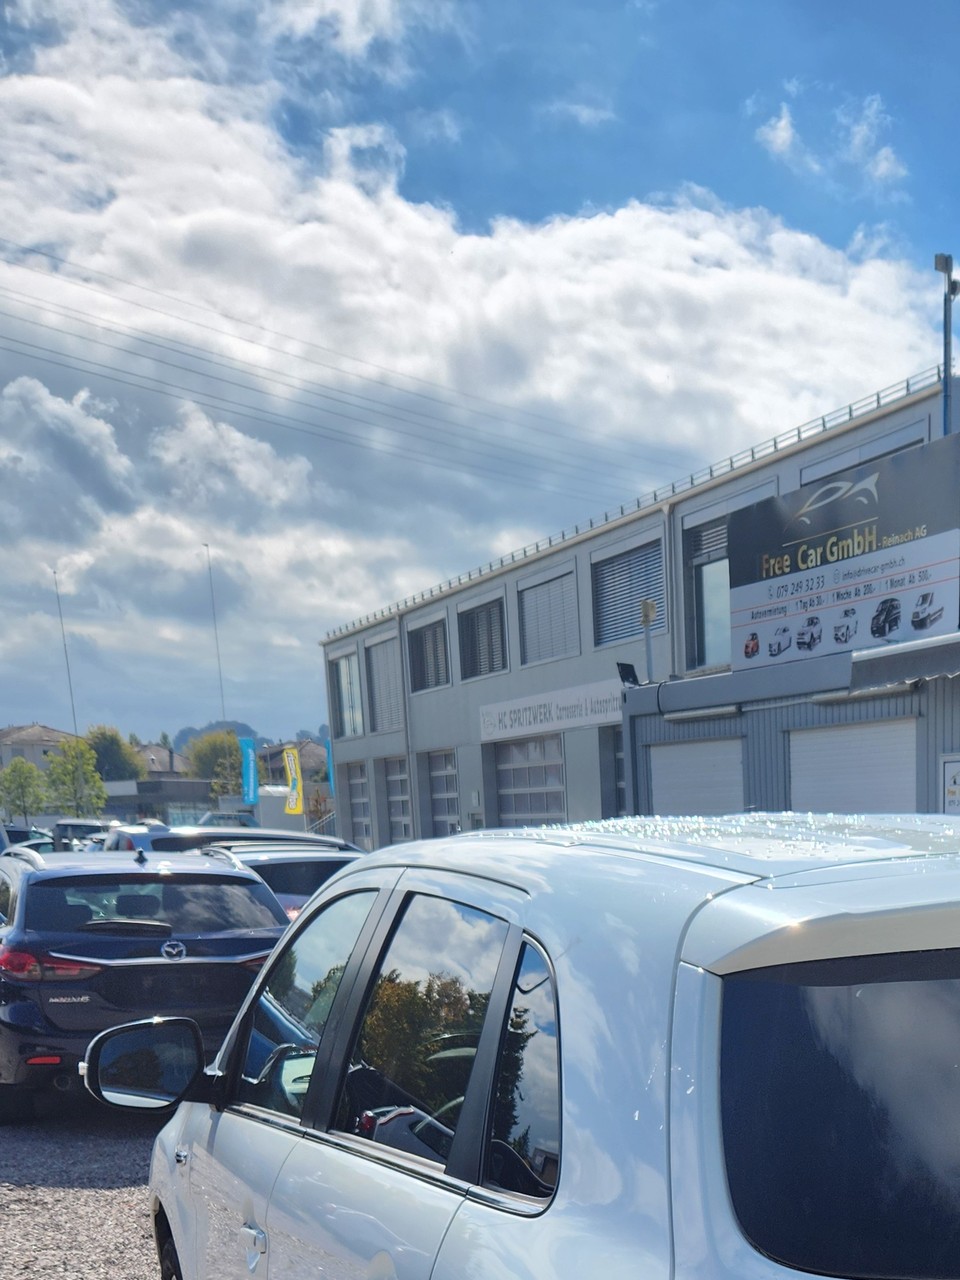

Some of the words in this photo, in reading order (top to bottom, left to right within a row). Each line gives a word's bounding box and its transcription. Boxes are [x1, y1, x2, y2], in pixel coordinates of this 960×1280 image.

[762, 553, 791, 578] Free
[797, 544, 824, 570] Car
[826, 525, 877, 562] GmbH
[882, 529, 914, 549] Reinach
[914, 524, 928, 540] AG
[776, 584, 789, 599] 079
